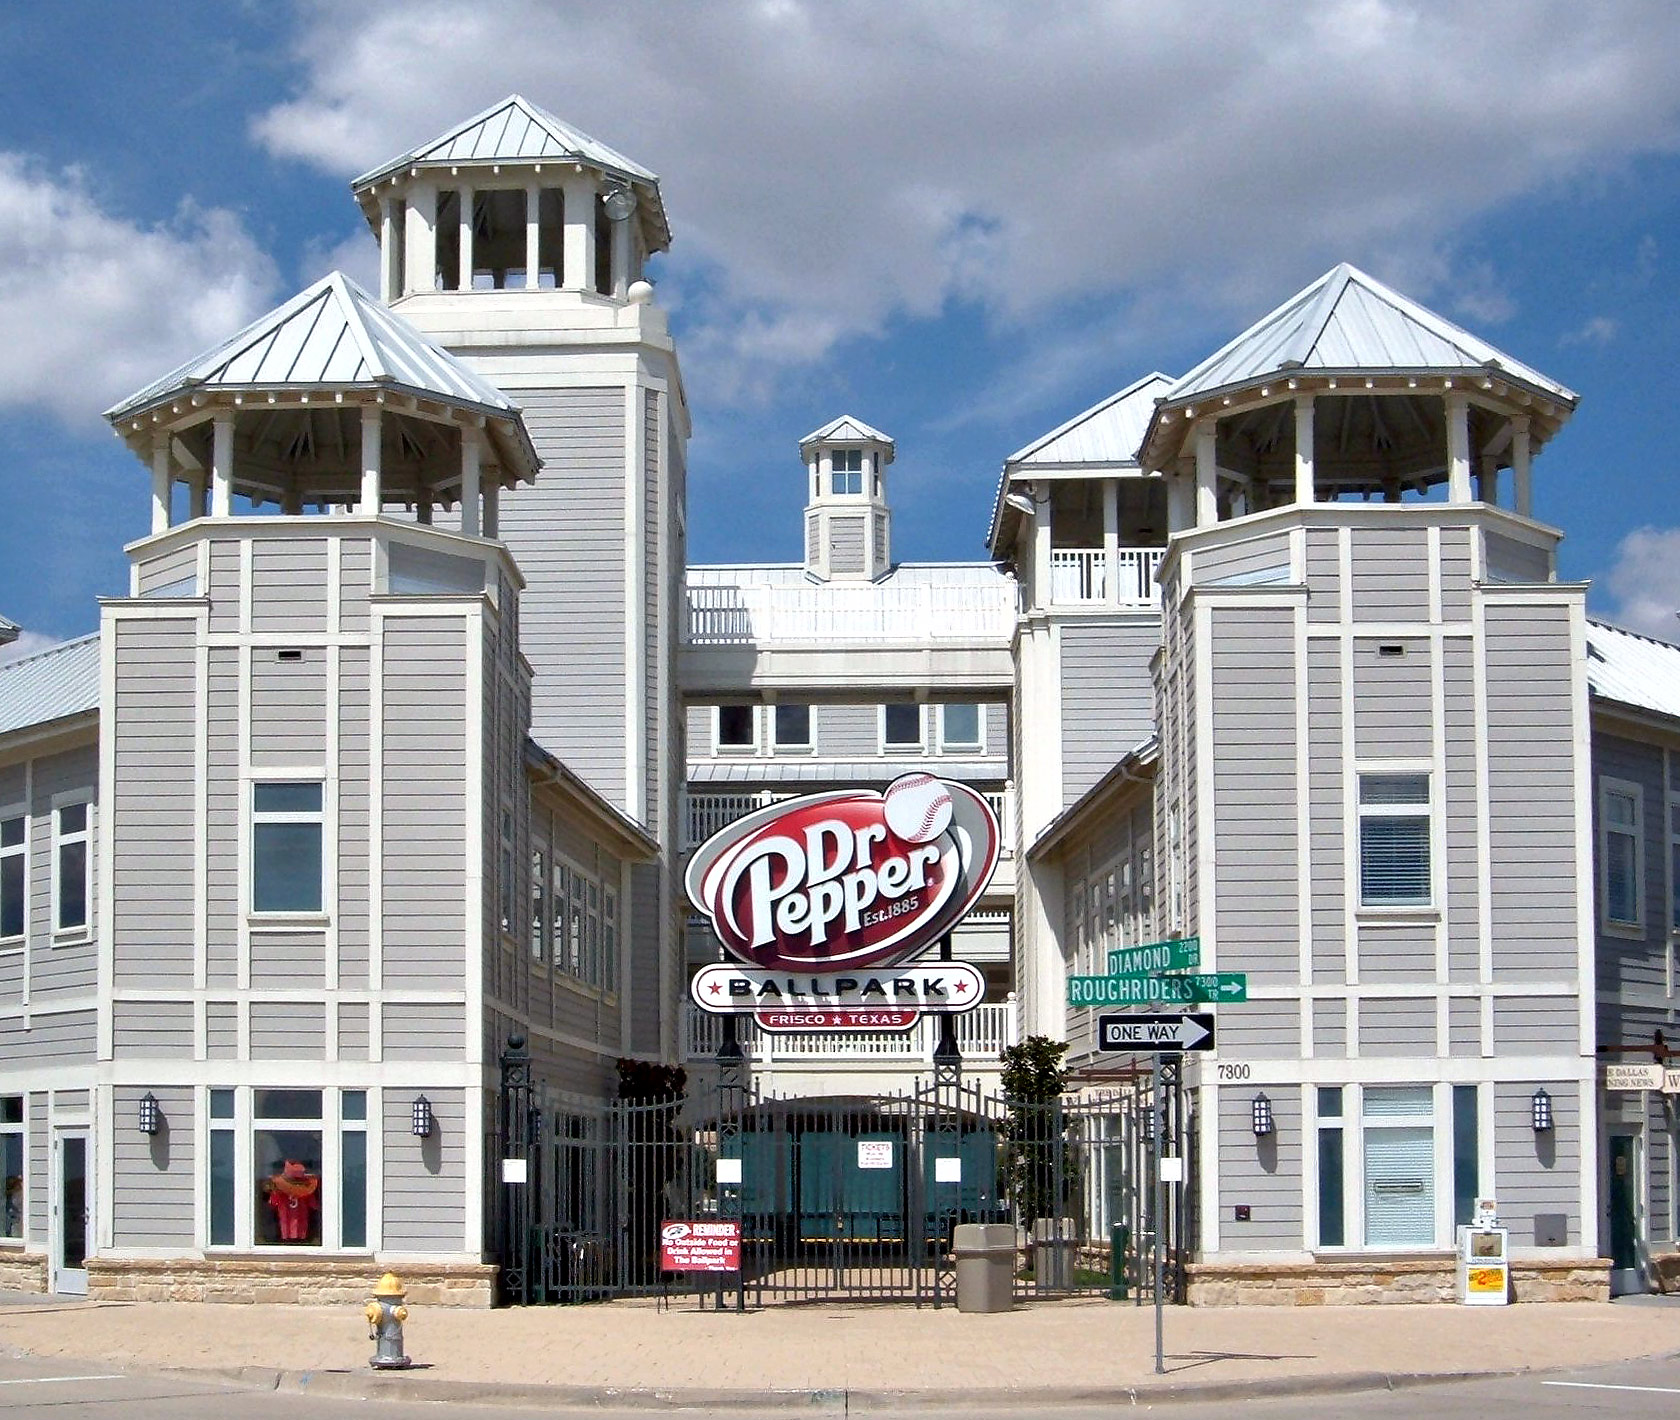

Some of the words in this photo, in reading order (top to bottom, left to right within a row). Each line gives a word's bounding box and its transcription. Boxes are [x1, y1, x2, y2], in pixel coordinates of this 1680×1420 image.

[803, 820, 887, 885] Dr
[722, 835, 940, 949] Pepper
[1109, 946, 1171, 975] DIAMOND
[1179, 940, 1198, 954] 2200
[1188, 954, 1199, 965] DR
[728, 978, 945, 998] BALLPARK
[1071, 977, 1194, 1001] ROUGHRIDERS
[1195, 976, 1218, 988] 7300
[1208, 990, 1219, 1000] TR
[769, 1014, 826, 1025] FRISCO
[850, 1014, 903, 1025] TEXAS
[1111, 1025, 1142, 1041] ONE
[1147, 1025, 1180, 1041] WAY
[1217, 1064, 1251, 1080] 7300
[1616, 1068, 1650, 1076] DALLAS
[1631, 1079, 1655, 1088] NEWS
[693, 1224, 736, 1236] REMINDER
[667, 1247, 689, 1255] Drink
[690, 1247, 723, 1255] Allowed
[674, 1256, 690, 1264] The
[691, 1256, 726, 1265] Ballpark
